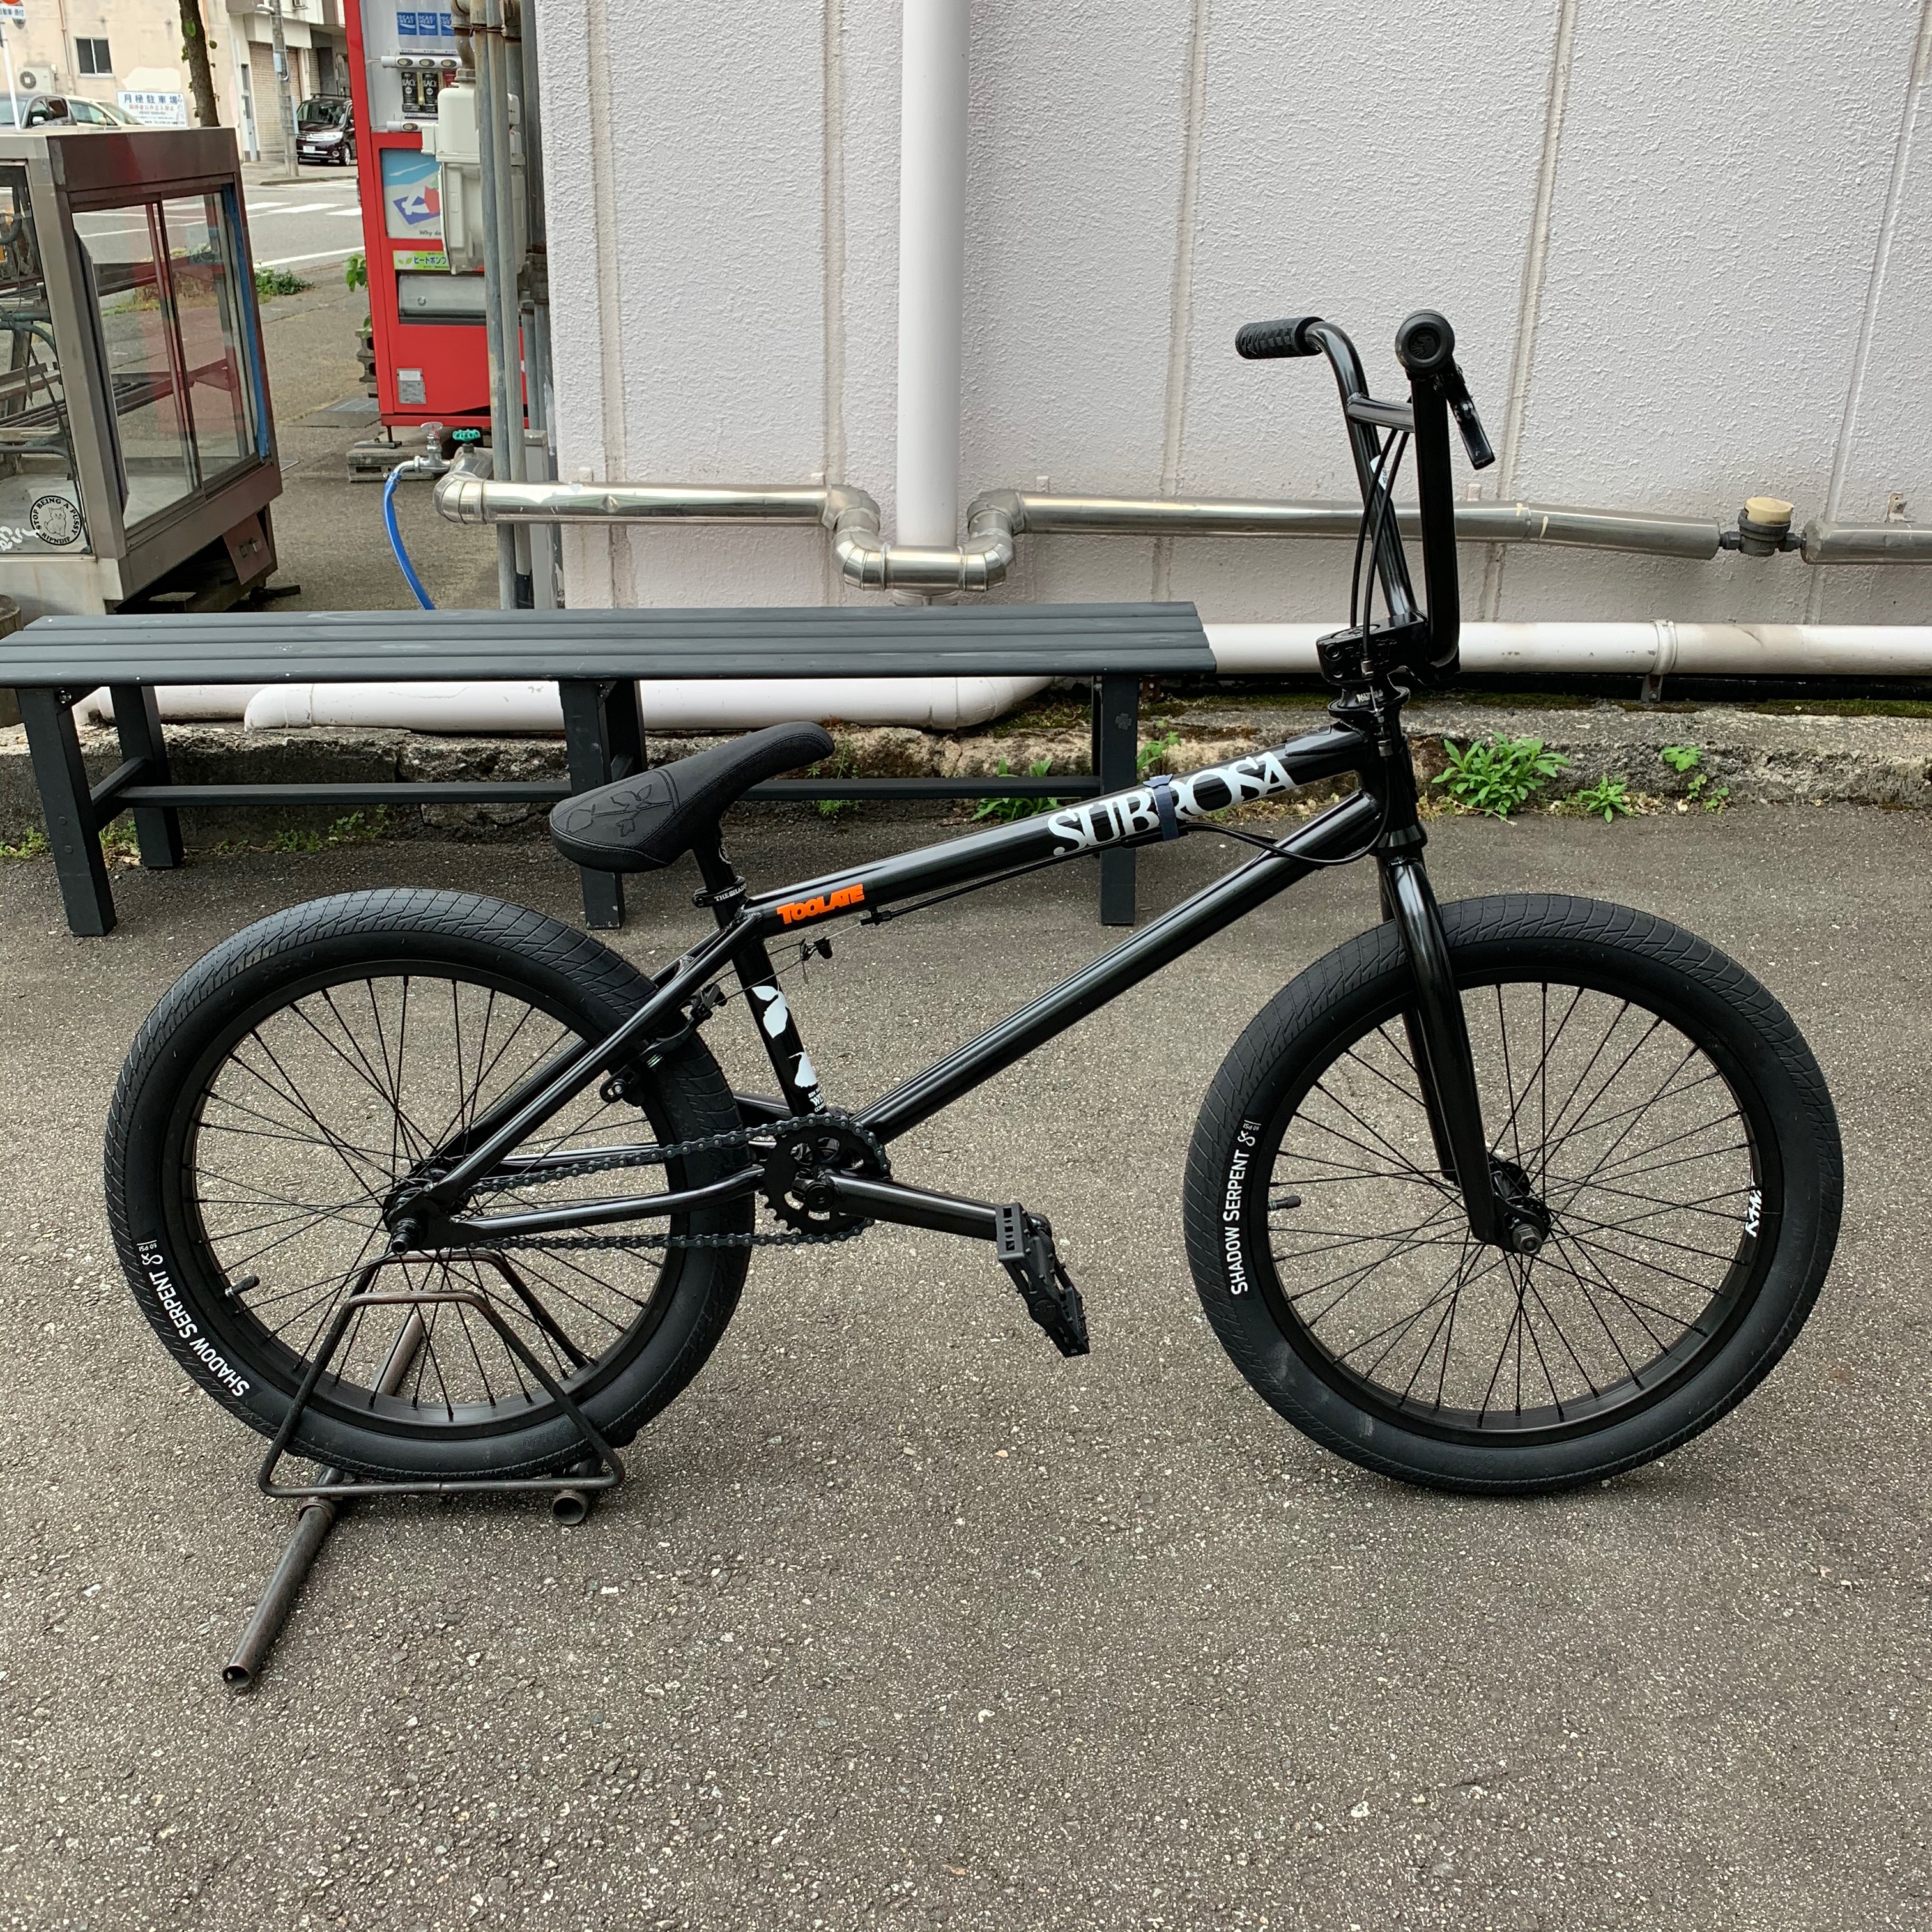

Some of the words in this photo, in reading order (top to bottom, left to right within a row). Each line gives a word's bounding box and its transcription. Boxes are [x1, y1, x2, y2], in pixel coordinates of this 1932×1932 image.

[124, 94, 177, 104] 月極駐車場
[36, 498, 61, 509] BEING
[33, 509, 42, 530] STOP
[70, 509, 79, 535] PUSSY
[714, 893, 730, 901] THE
[1223, 1149, 1250, 1222] SERPENT
[1225, 1227, 1248, 1295] SHADOW
[149, 1271, 198, 1338] SERPENT
[189, 1337, 250, 1397] SHADOW
